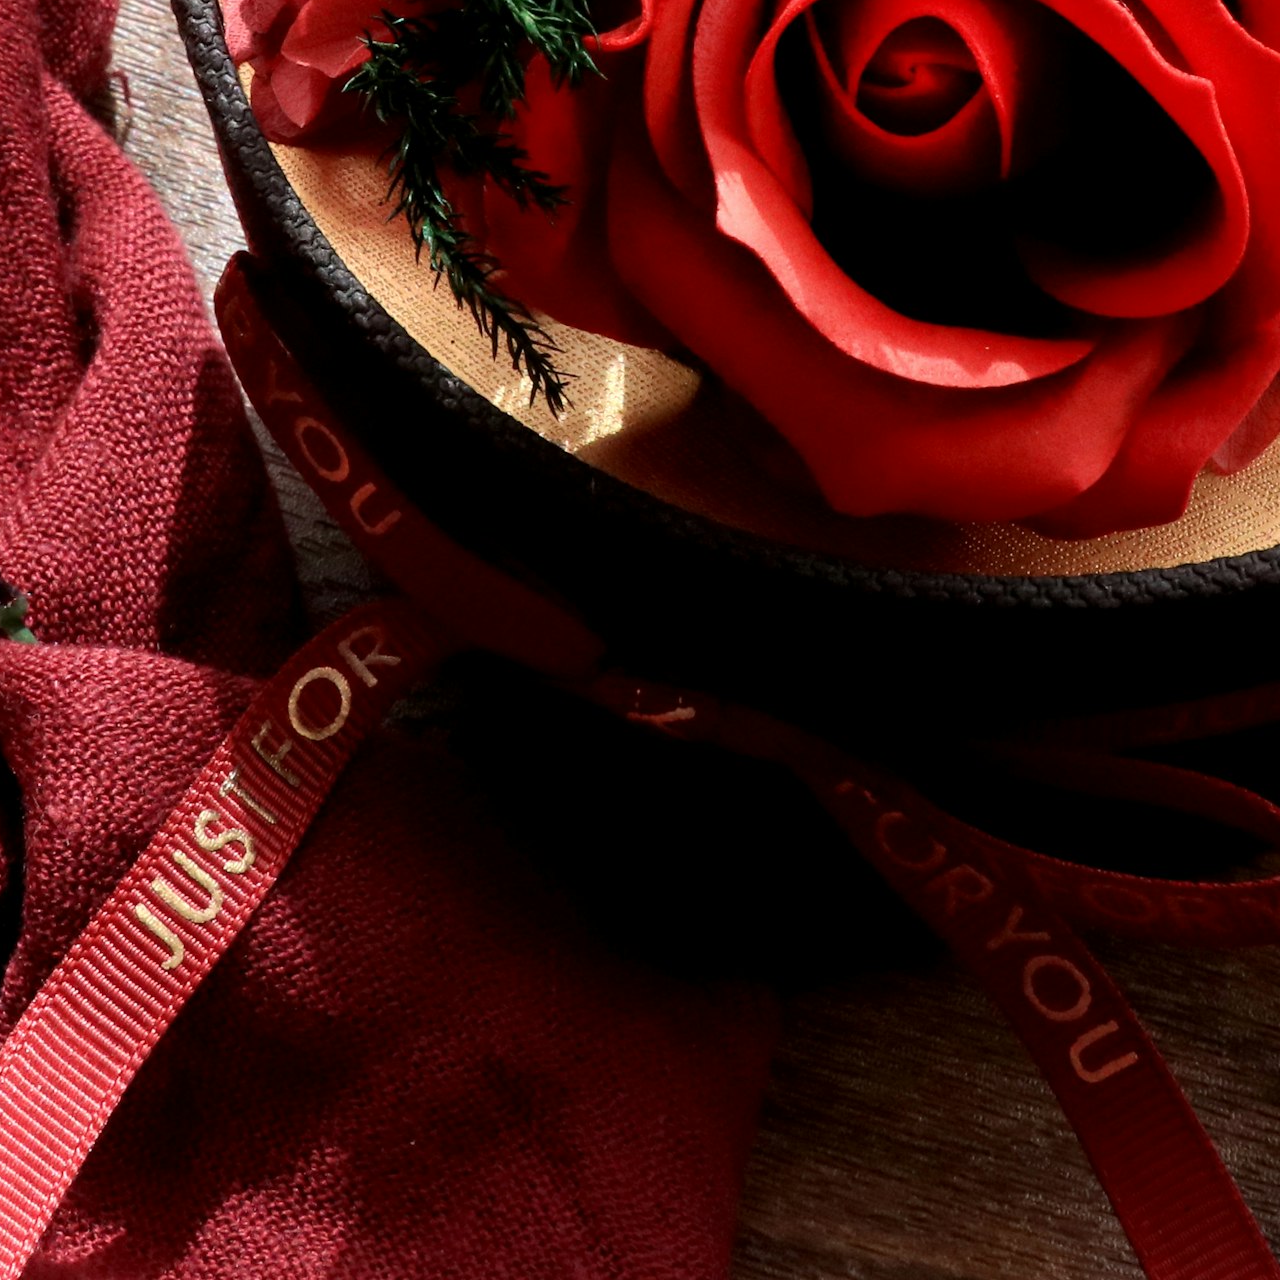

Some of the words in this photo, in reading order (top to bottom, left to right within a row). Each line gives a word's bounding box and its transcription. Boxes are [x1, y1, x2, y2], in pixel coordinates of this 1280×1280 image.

[266, 358, 402, 536] YOU
[135, 768, 277, 971] JUST
[251, 625, 402, 788] FOR
[986, 905, 1139, 1083] YOU
